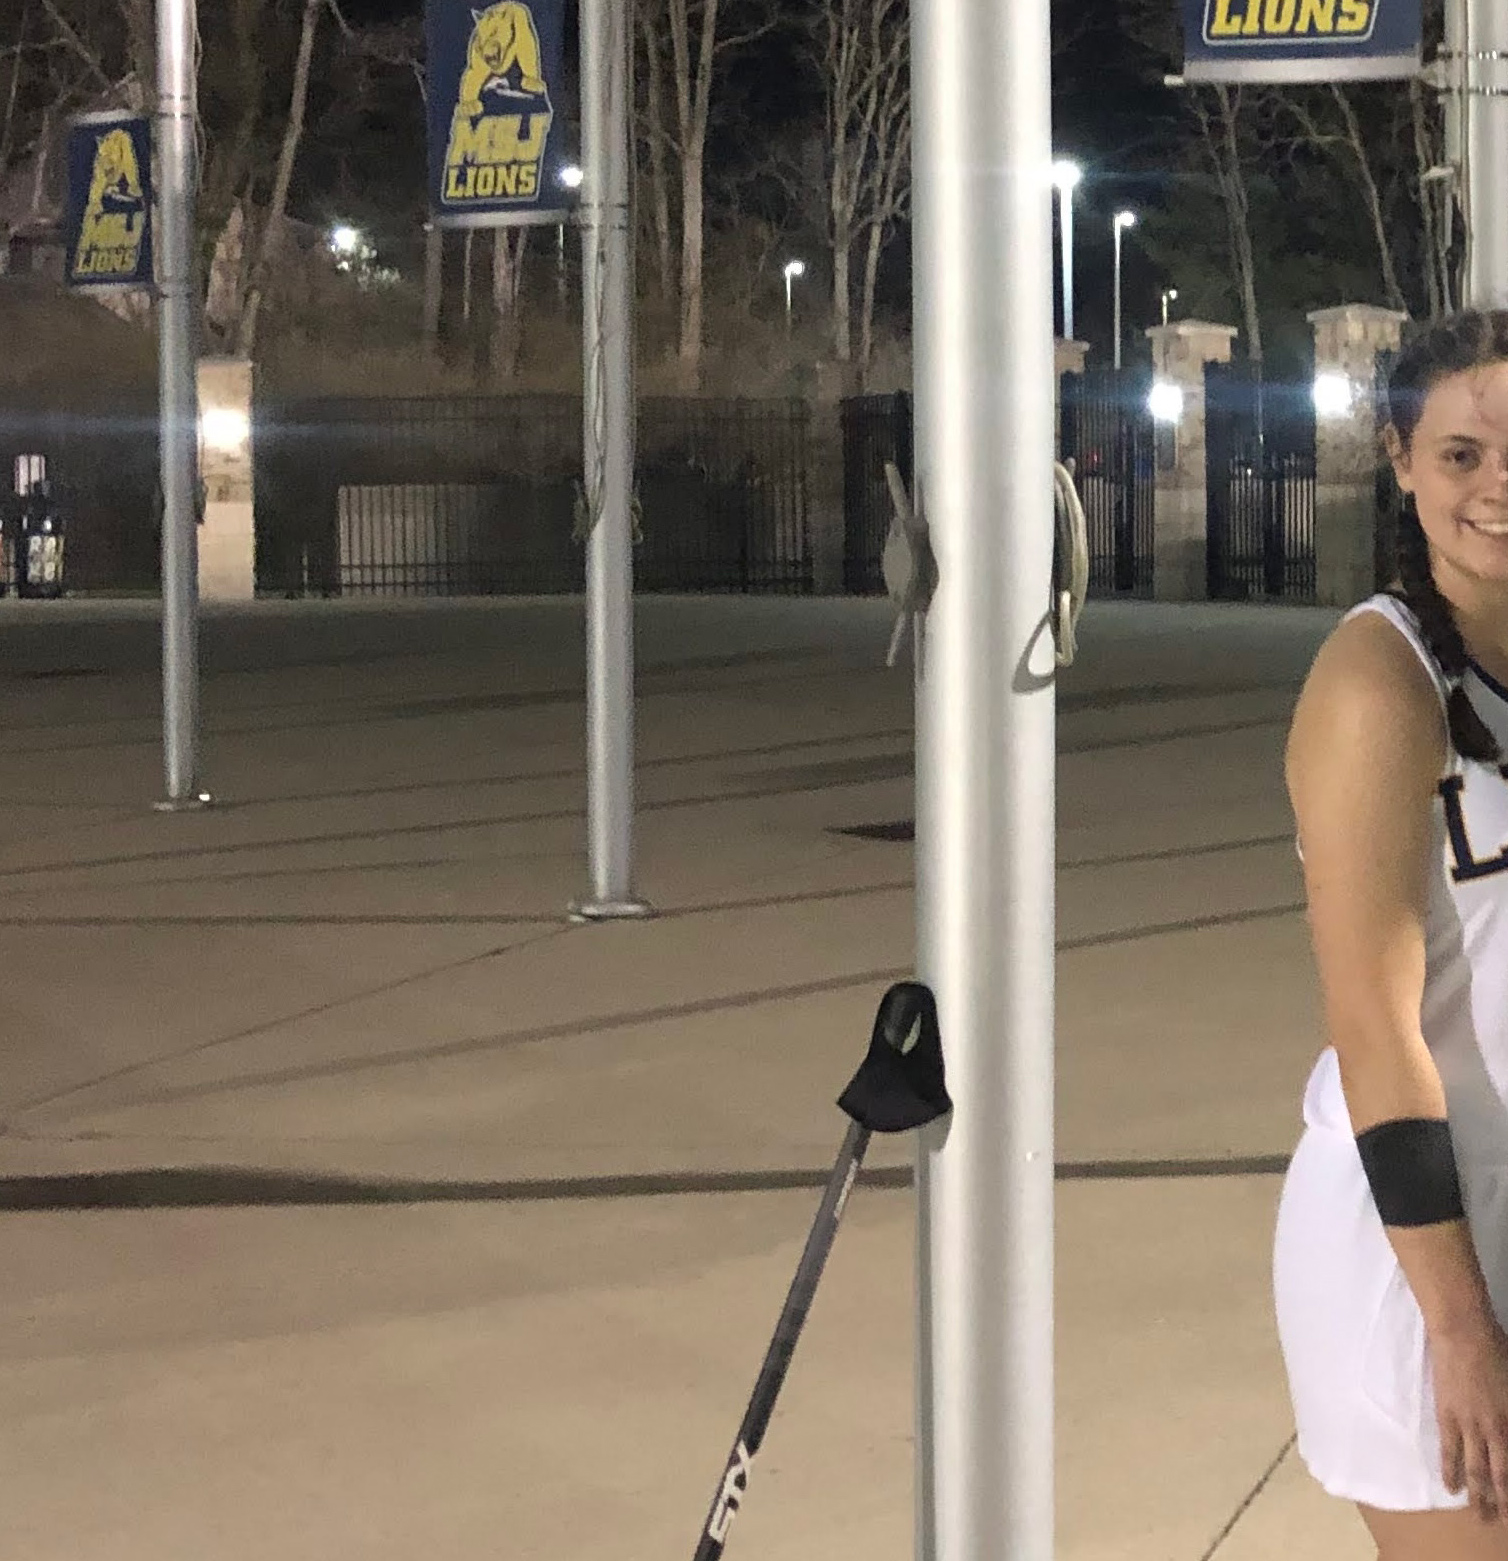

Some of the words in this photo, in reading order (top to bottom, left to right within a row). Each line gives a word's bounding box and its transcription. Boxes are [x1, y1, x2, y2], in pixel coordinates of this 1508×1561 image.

[1210, 0, 1369, 35] LIONS
[446, 163, 537, 198] LIONS
[76, 249, 136, 273] LIONS
[708, 1438, 751, 1544] STX
